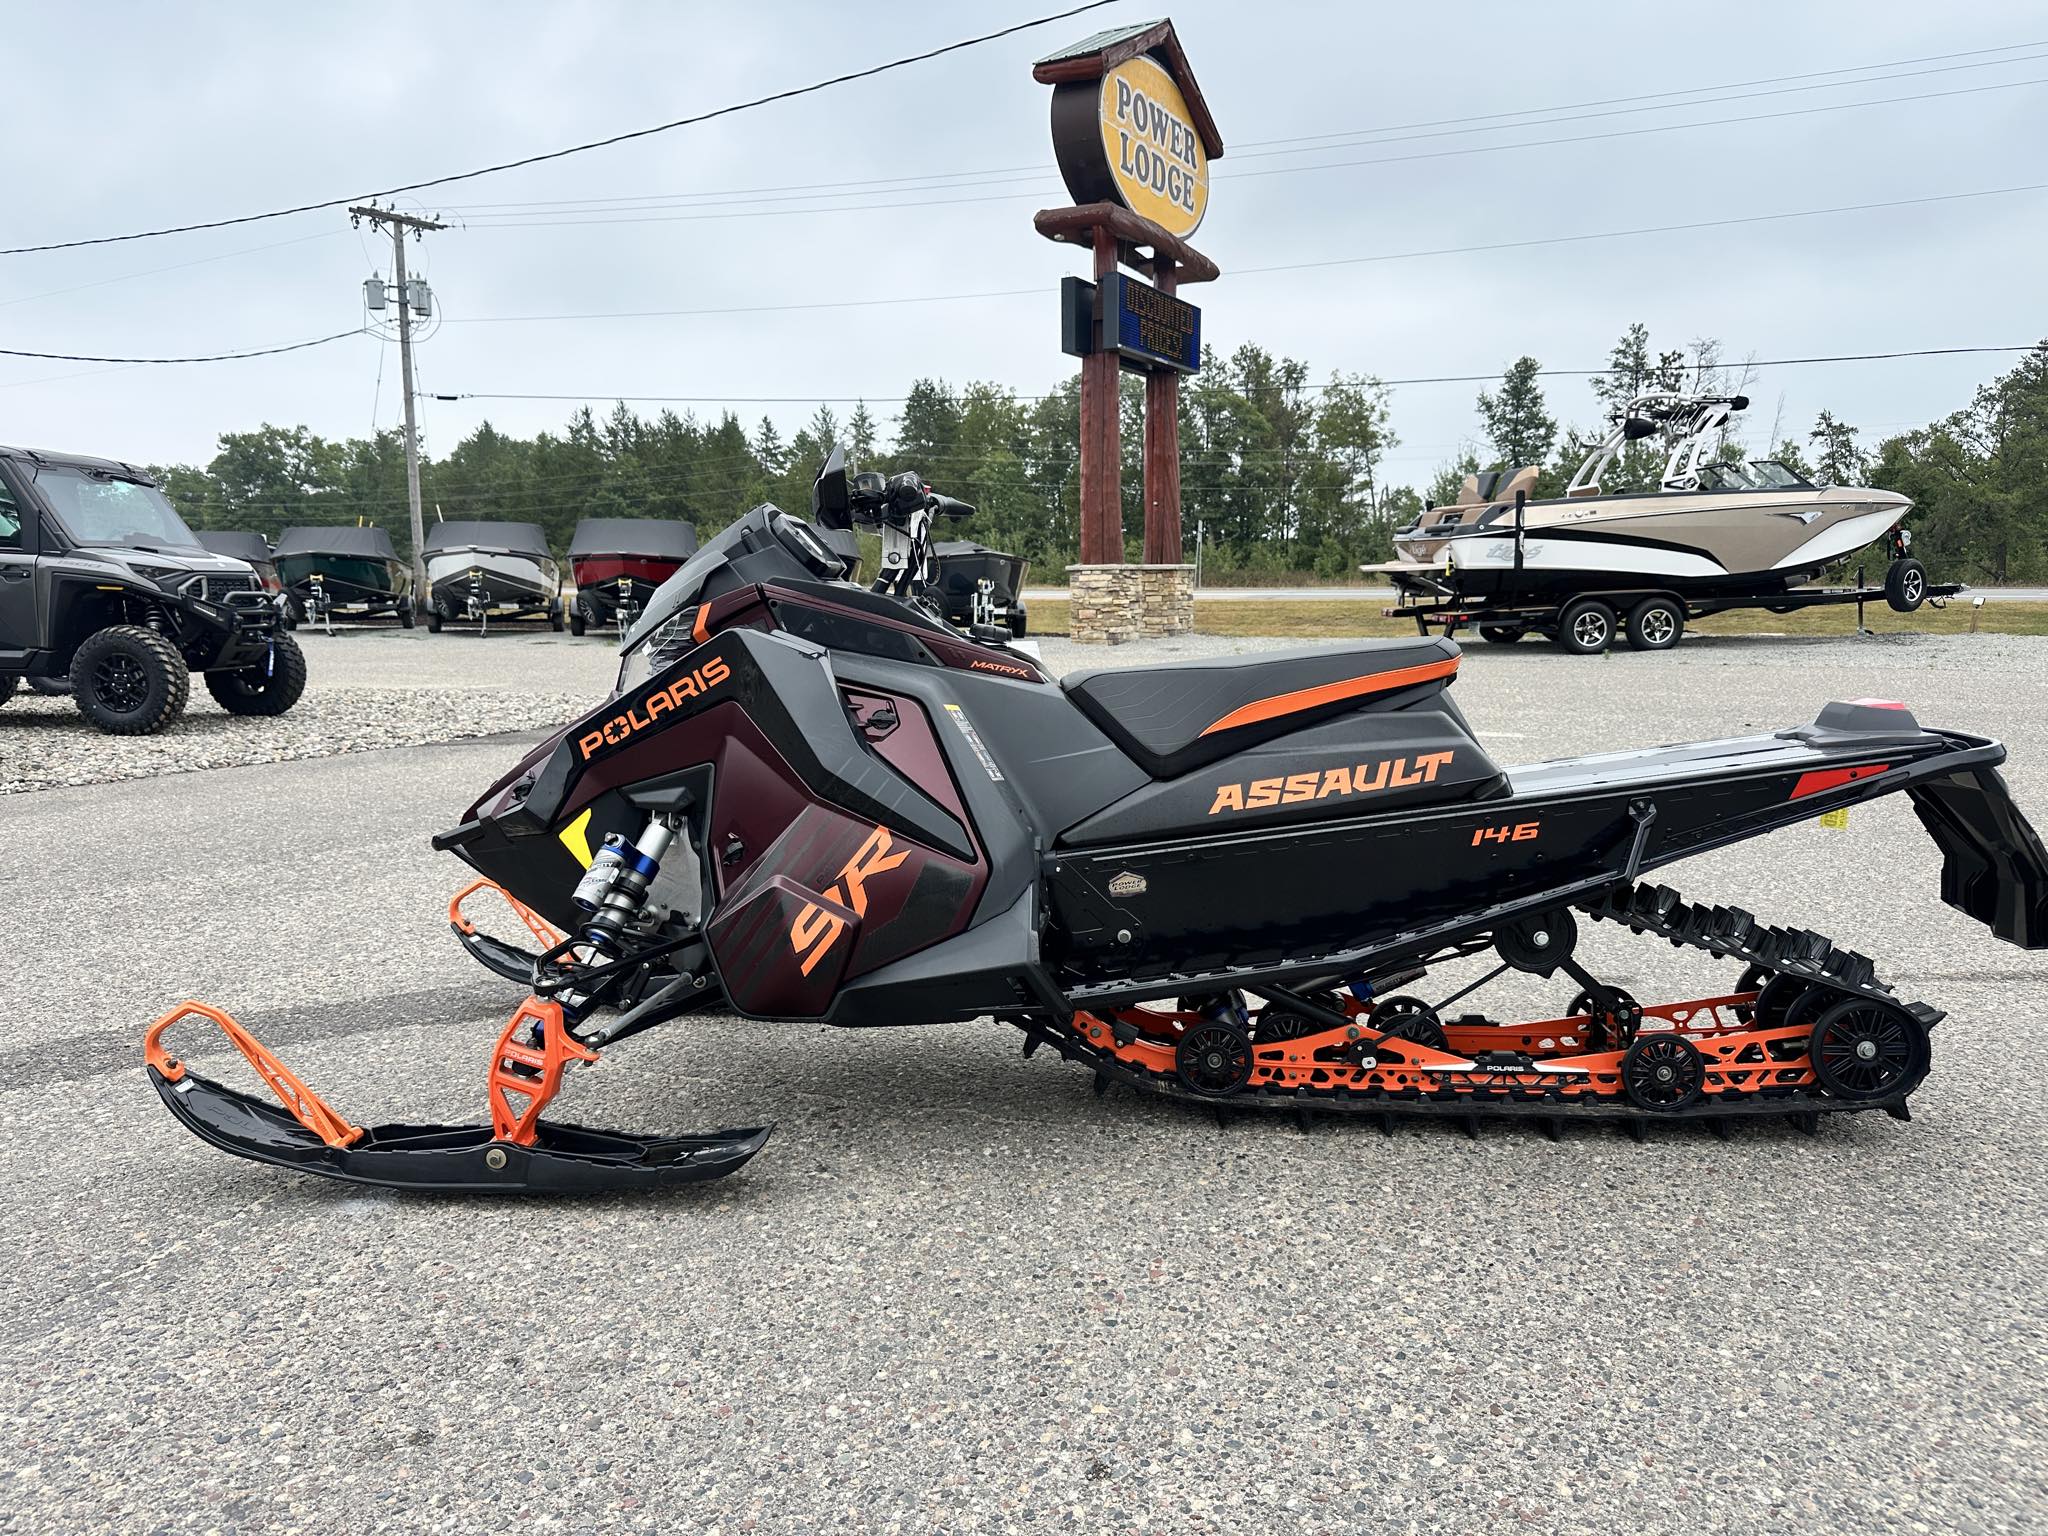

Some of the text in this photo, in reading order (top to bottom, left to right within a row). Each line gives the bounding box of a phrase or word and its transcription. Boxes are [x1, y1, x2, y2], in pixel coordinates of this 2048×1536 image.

[1116, 78, 1197, 169] POWER
[1120, 132, 1194, 212] LODGE
[1126, 281, 1193, 335] DISCOUNTED
[970, 660, 1029, 678] MATRYX
[579, 656, 731, 760] POLARIS
[1208, 751, 1454, 815] ASSAULT
[1471, 821, 1540, 846] 146
[1112, 879, 1142, 888] POWER
[503, 1048, 544, 1066] POLARIS
